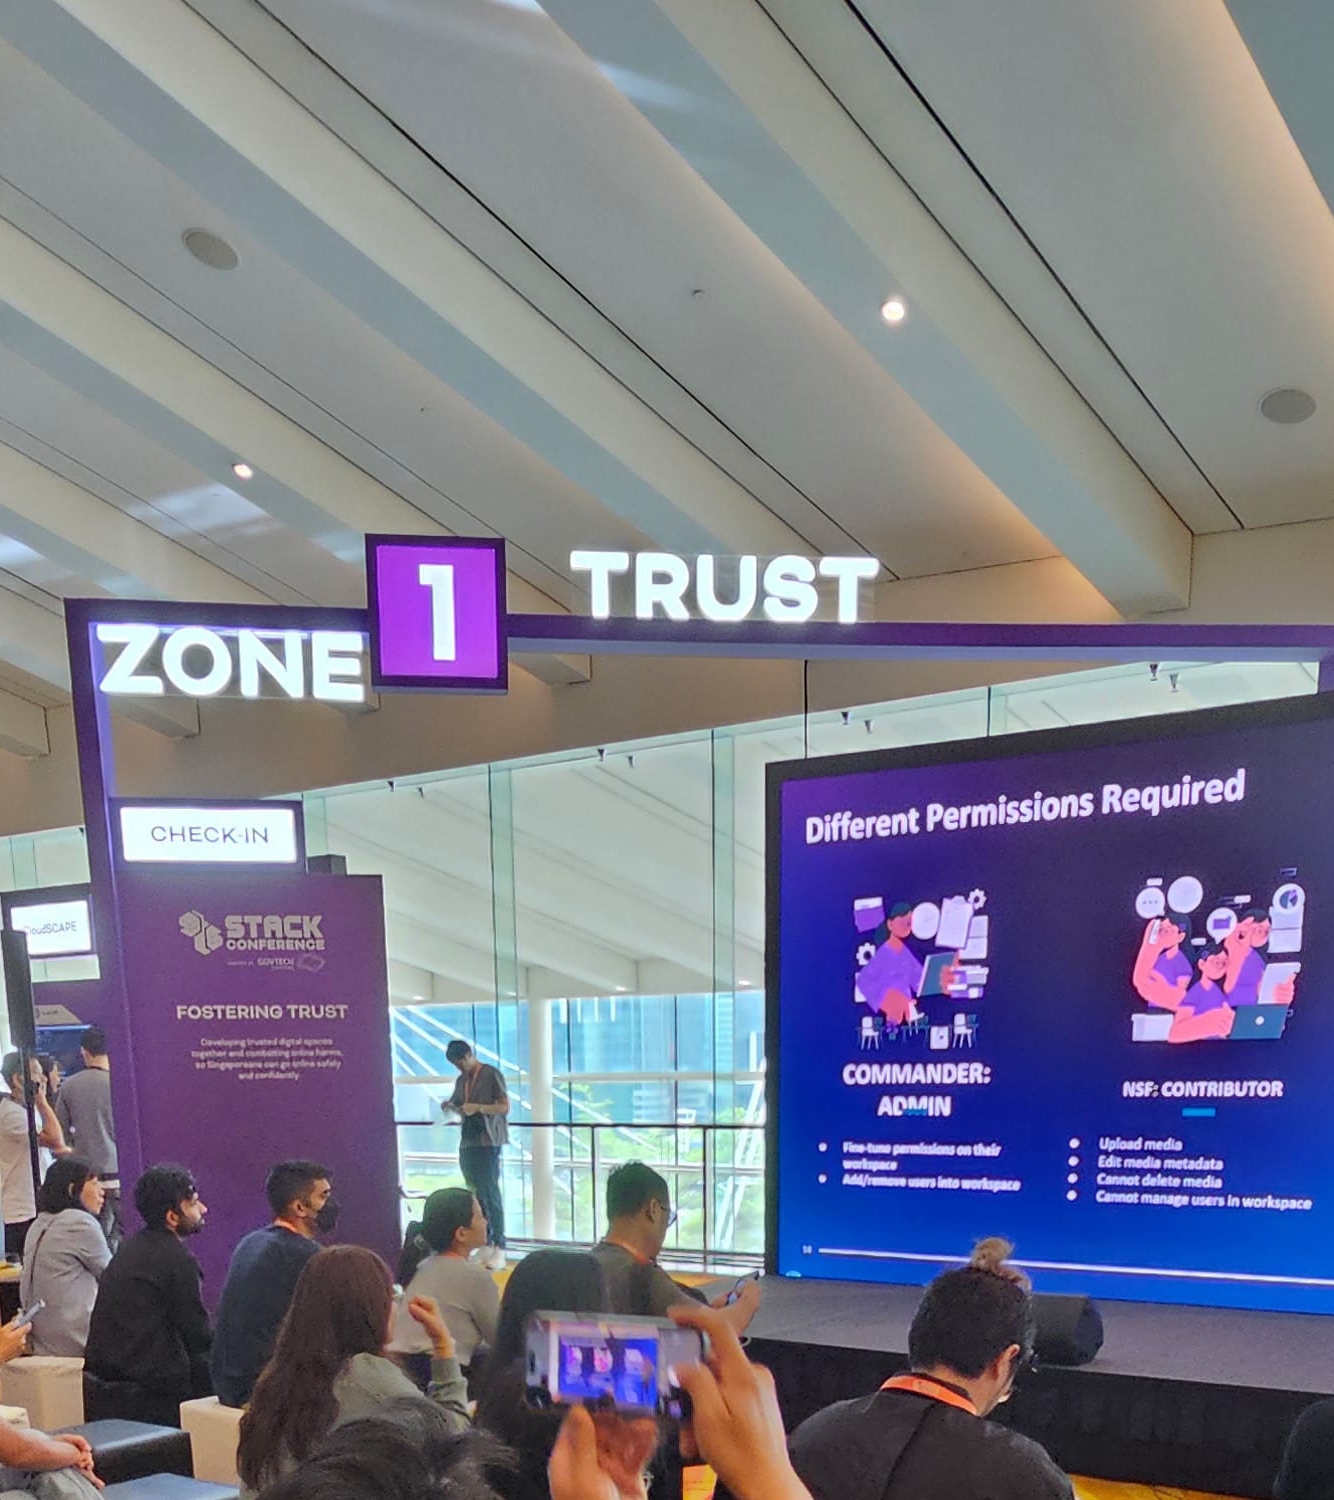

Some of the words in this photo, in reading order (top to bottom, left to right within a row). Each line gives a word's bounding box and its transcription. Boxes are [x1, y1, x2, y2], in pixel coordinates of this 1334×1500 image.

[569, 549, 880, 624] TRUST
[417, 563, 457, 662] 1
[96, 622, 365, 703] ZONE
[805, 808, 920, 844] Different
[926, 791, 1094, 831] Permissions
[1102, 767, 1246, 817] Required
[151, 825, 269, 844] CHECK-IN
[224, 915, 323, 939] STACK
[226, 939, 325, 951] CONFERENCE
[176, 1005, 283, 1020] FOSTERING
[286, 1004, 348, 1020] TRUST
[842, 1062, 992, 1086] COMMANDER:
[1122, 1080, 1160, 1098] NSF:
[1161, 1080, 1284, 1098] CONTRIBUTOR
[877, 1095, 952, 1117] ADMIN
[842, 1141, 891, 1154] Fine-tune
[893, 1142, 956, 1157] permissions
[956, 1146, 972, 1156] on
[973, 1143, 1002, 1157] their
[1099, 1137, 1143, 1152] Upload
[1144, 1138, 1183, 1151] media
[842, 1158, 898, 1172] workspace
[1098, 1155, 1123, 1169] Edit
[1123, 1156, 1161, 1169] media
[1163, 1157, 1224, 1171] metadata
[842, 1173, 907, 1188] Add/remove
[908, 1177, 937, 1189] users
[937, 1175, 960, 1189] into
[961, 1178, 1022, 1193] workspace
[1096, 1173, 1141, 1186] Cannot
[1142, 1174, 1181, 1187] delete
[1183, 1175, 1223, 1188] media
[1095, 1190, 1140, 1204] Cannot
[1141, 1194, 1189, 1207] manage
[1191, 1195, 1225, 1207] users
[1227, 1194, 1240, 1207] in
[1242, 1195, 1313, 1211] workspace
